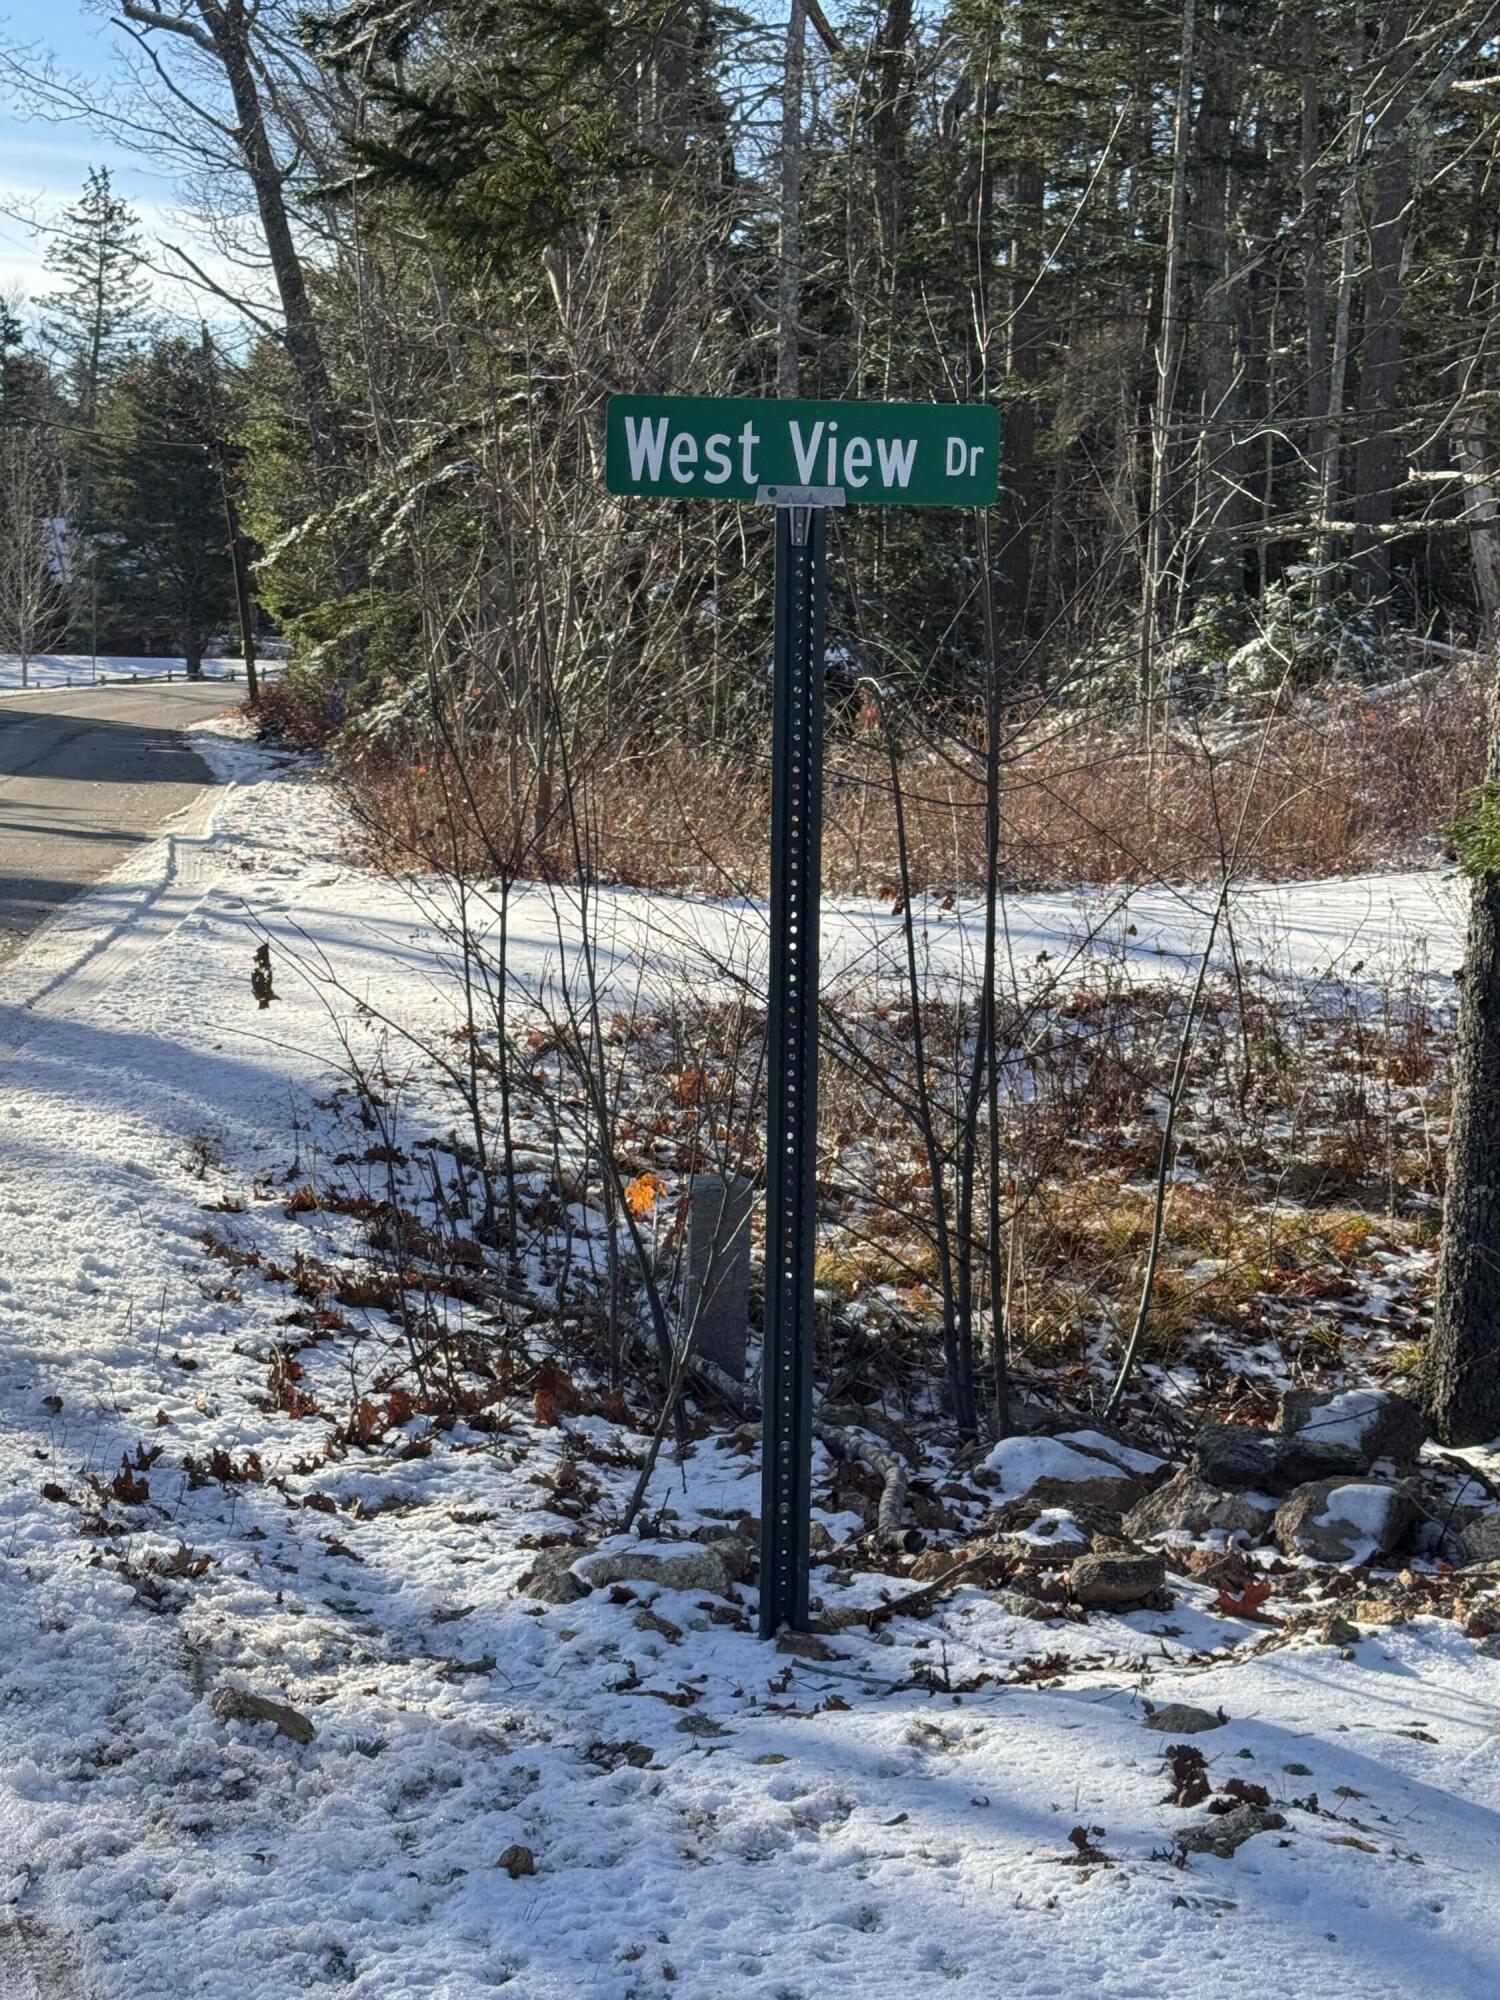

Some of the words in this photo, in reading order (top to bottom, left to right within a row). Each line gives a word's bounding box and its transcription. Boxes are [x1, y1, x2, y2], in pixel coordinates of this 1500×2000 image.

[624, 416, 760, 485] West
[788, 420, 918, 488] View
[945, 436, 984, 477] Dr
